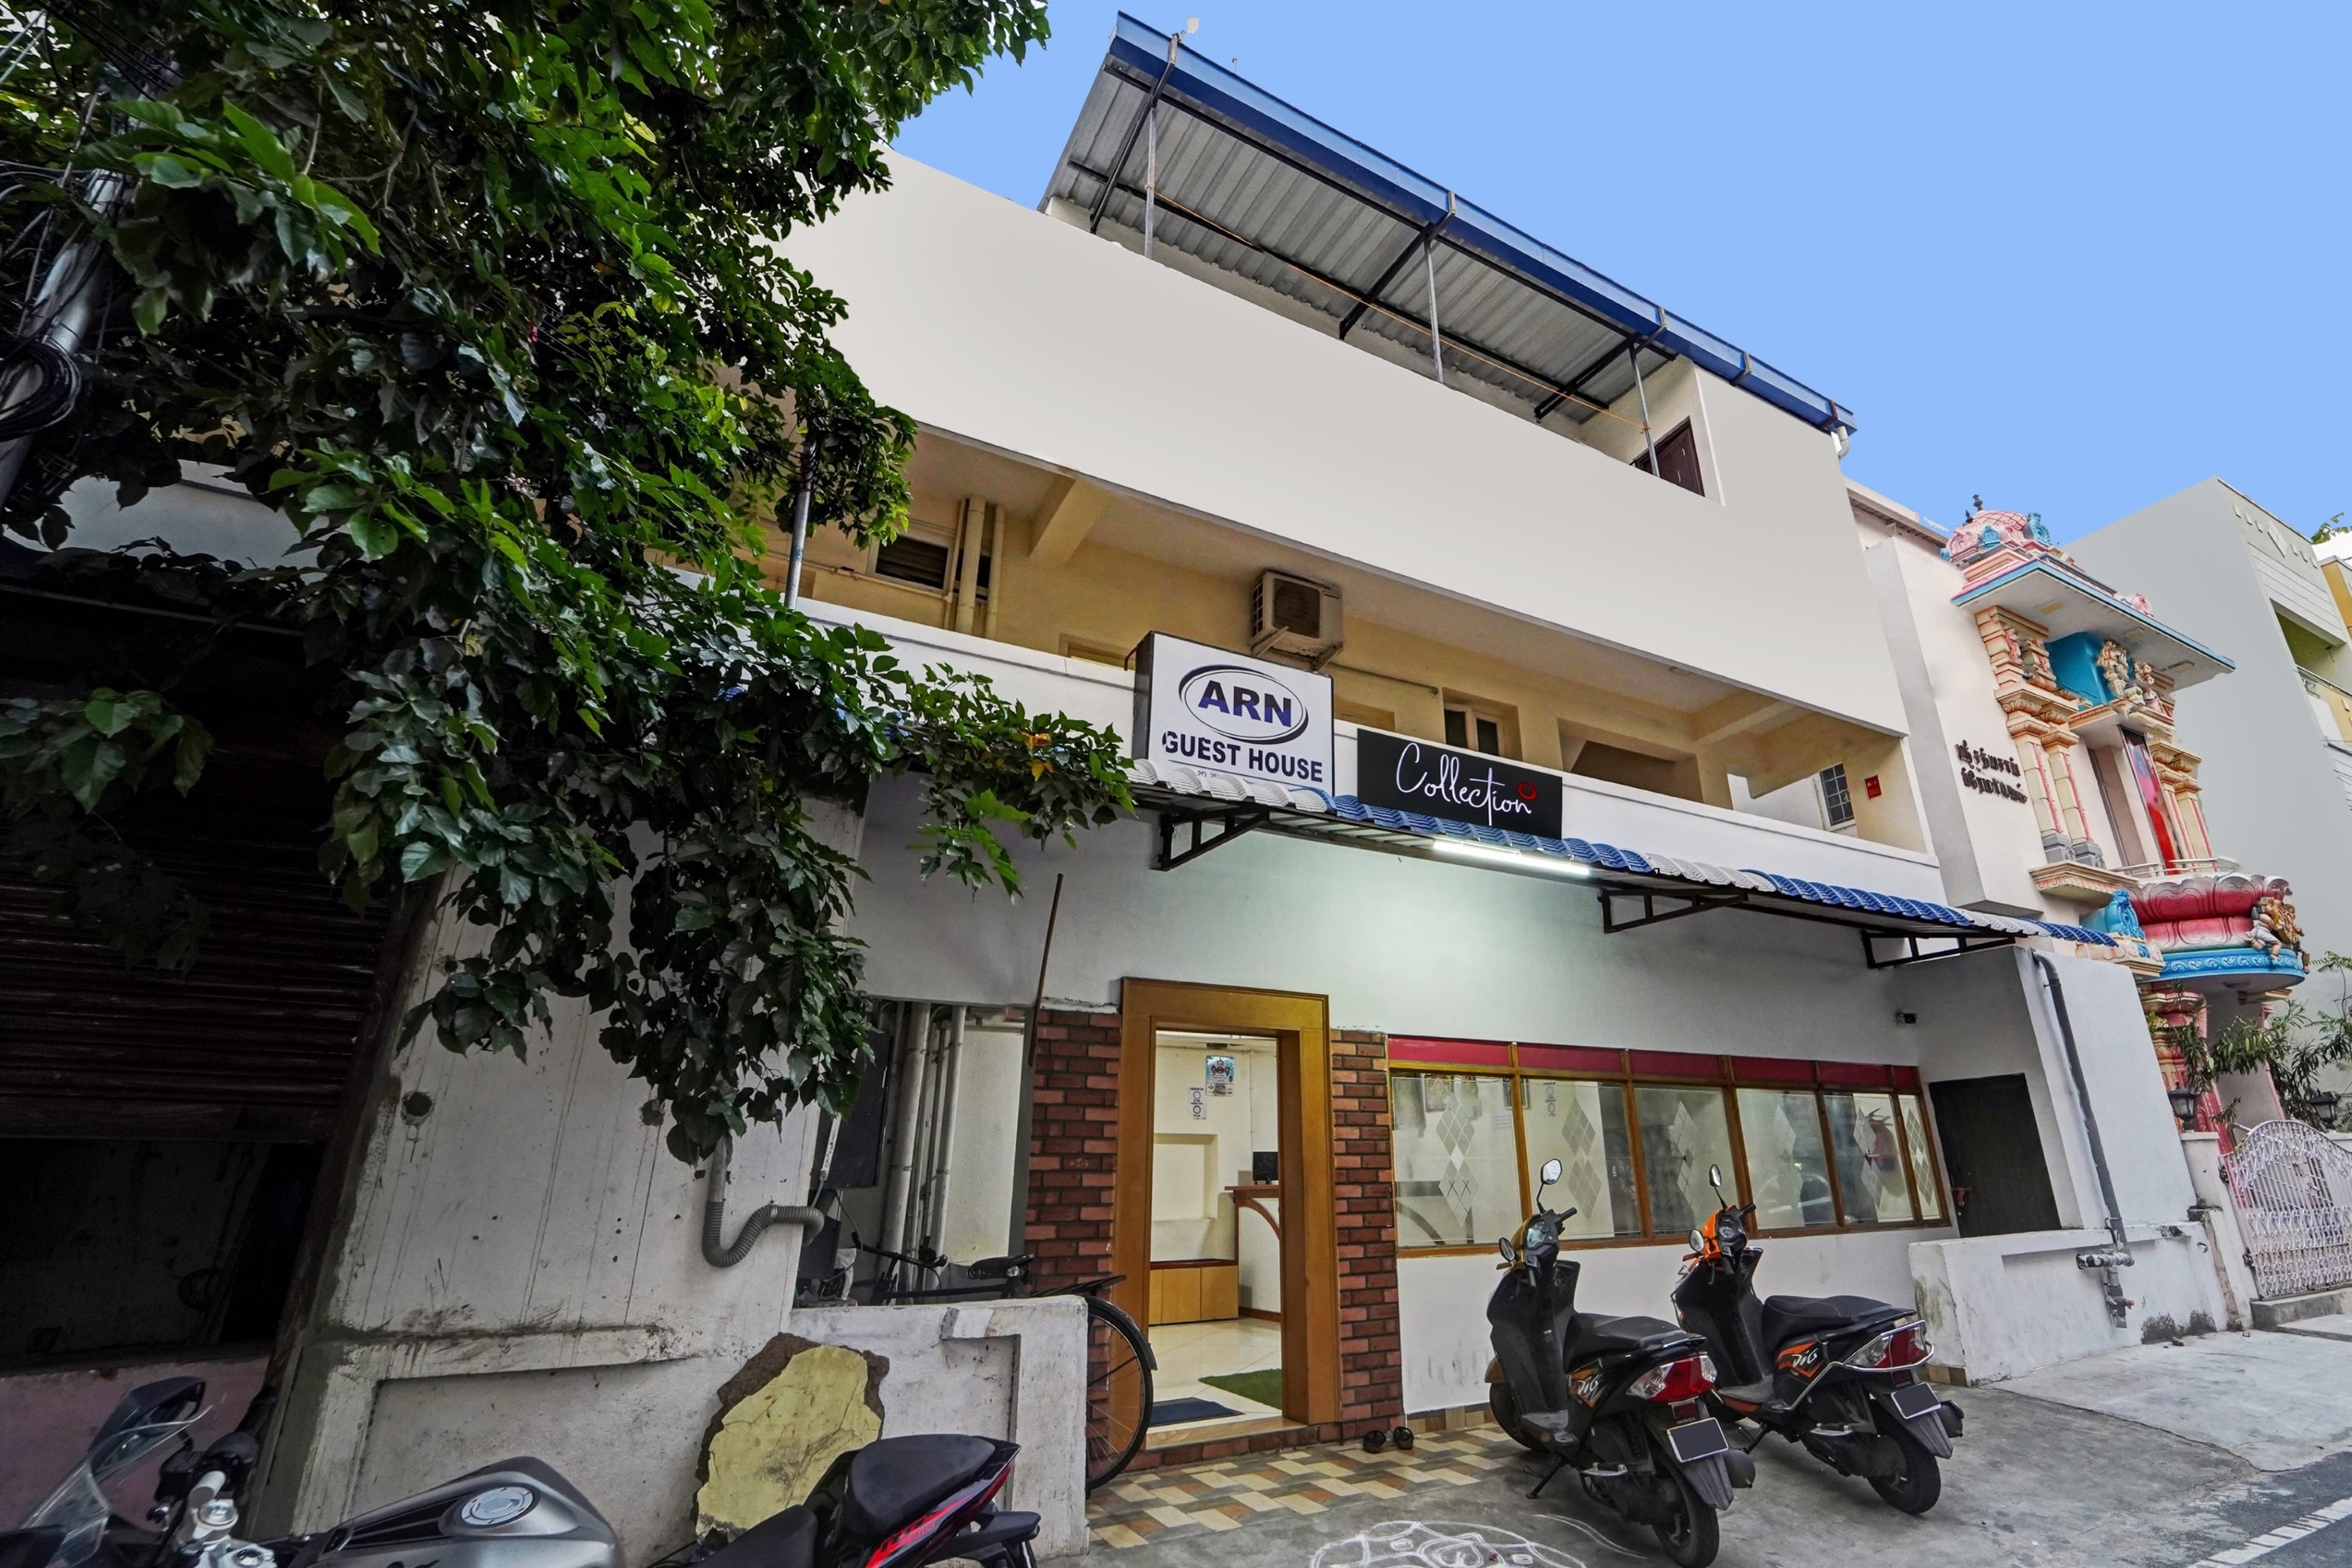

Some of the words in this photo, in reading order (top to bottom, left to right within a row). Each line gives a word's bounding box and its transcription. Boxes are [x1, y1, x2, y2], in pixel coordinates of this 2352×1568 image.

[1197, 679, 1292, 728] ARN
[1162, 730, 1241, 766] GUEST
[1249, 747, 1323, 783] HOUSE
[1396, 742, 1532, 826] Collection
[1677, 1417, 1696, 1425] HONDA
